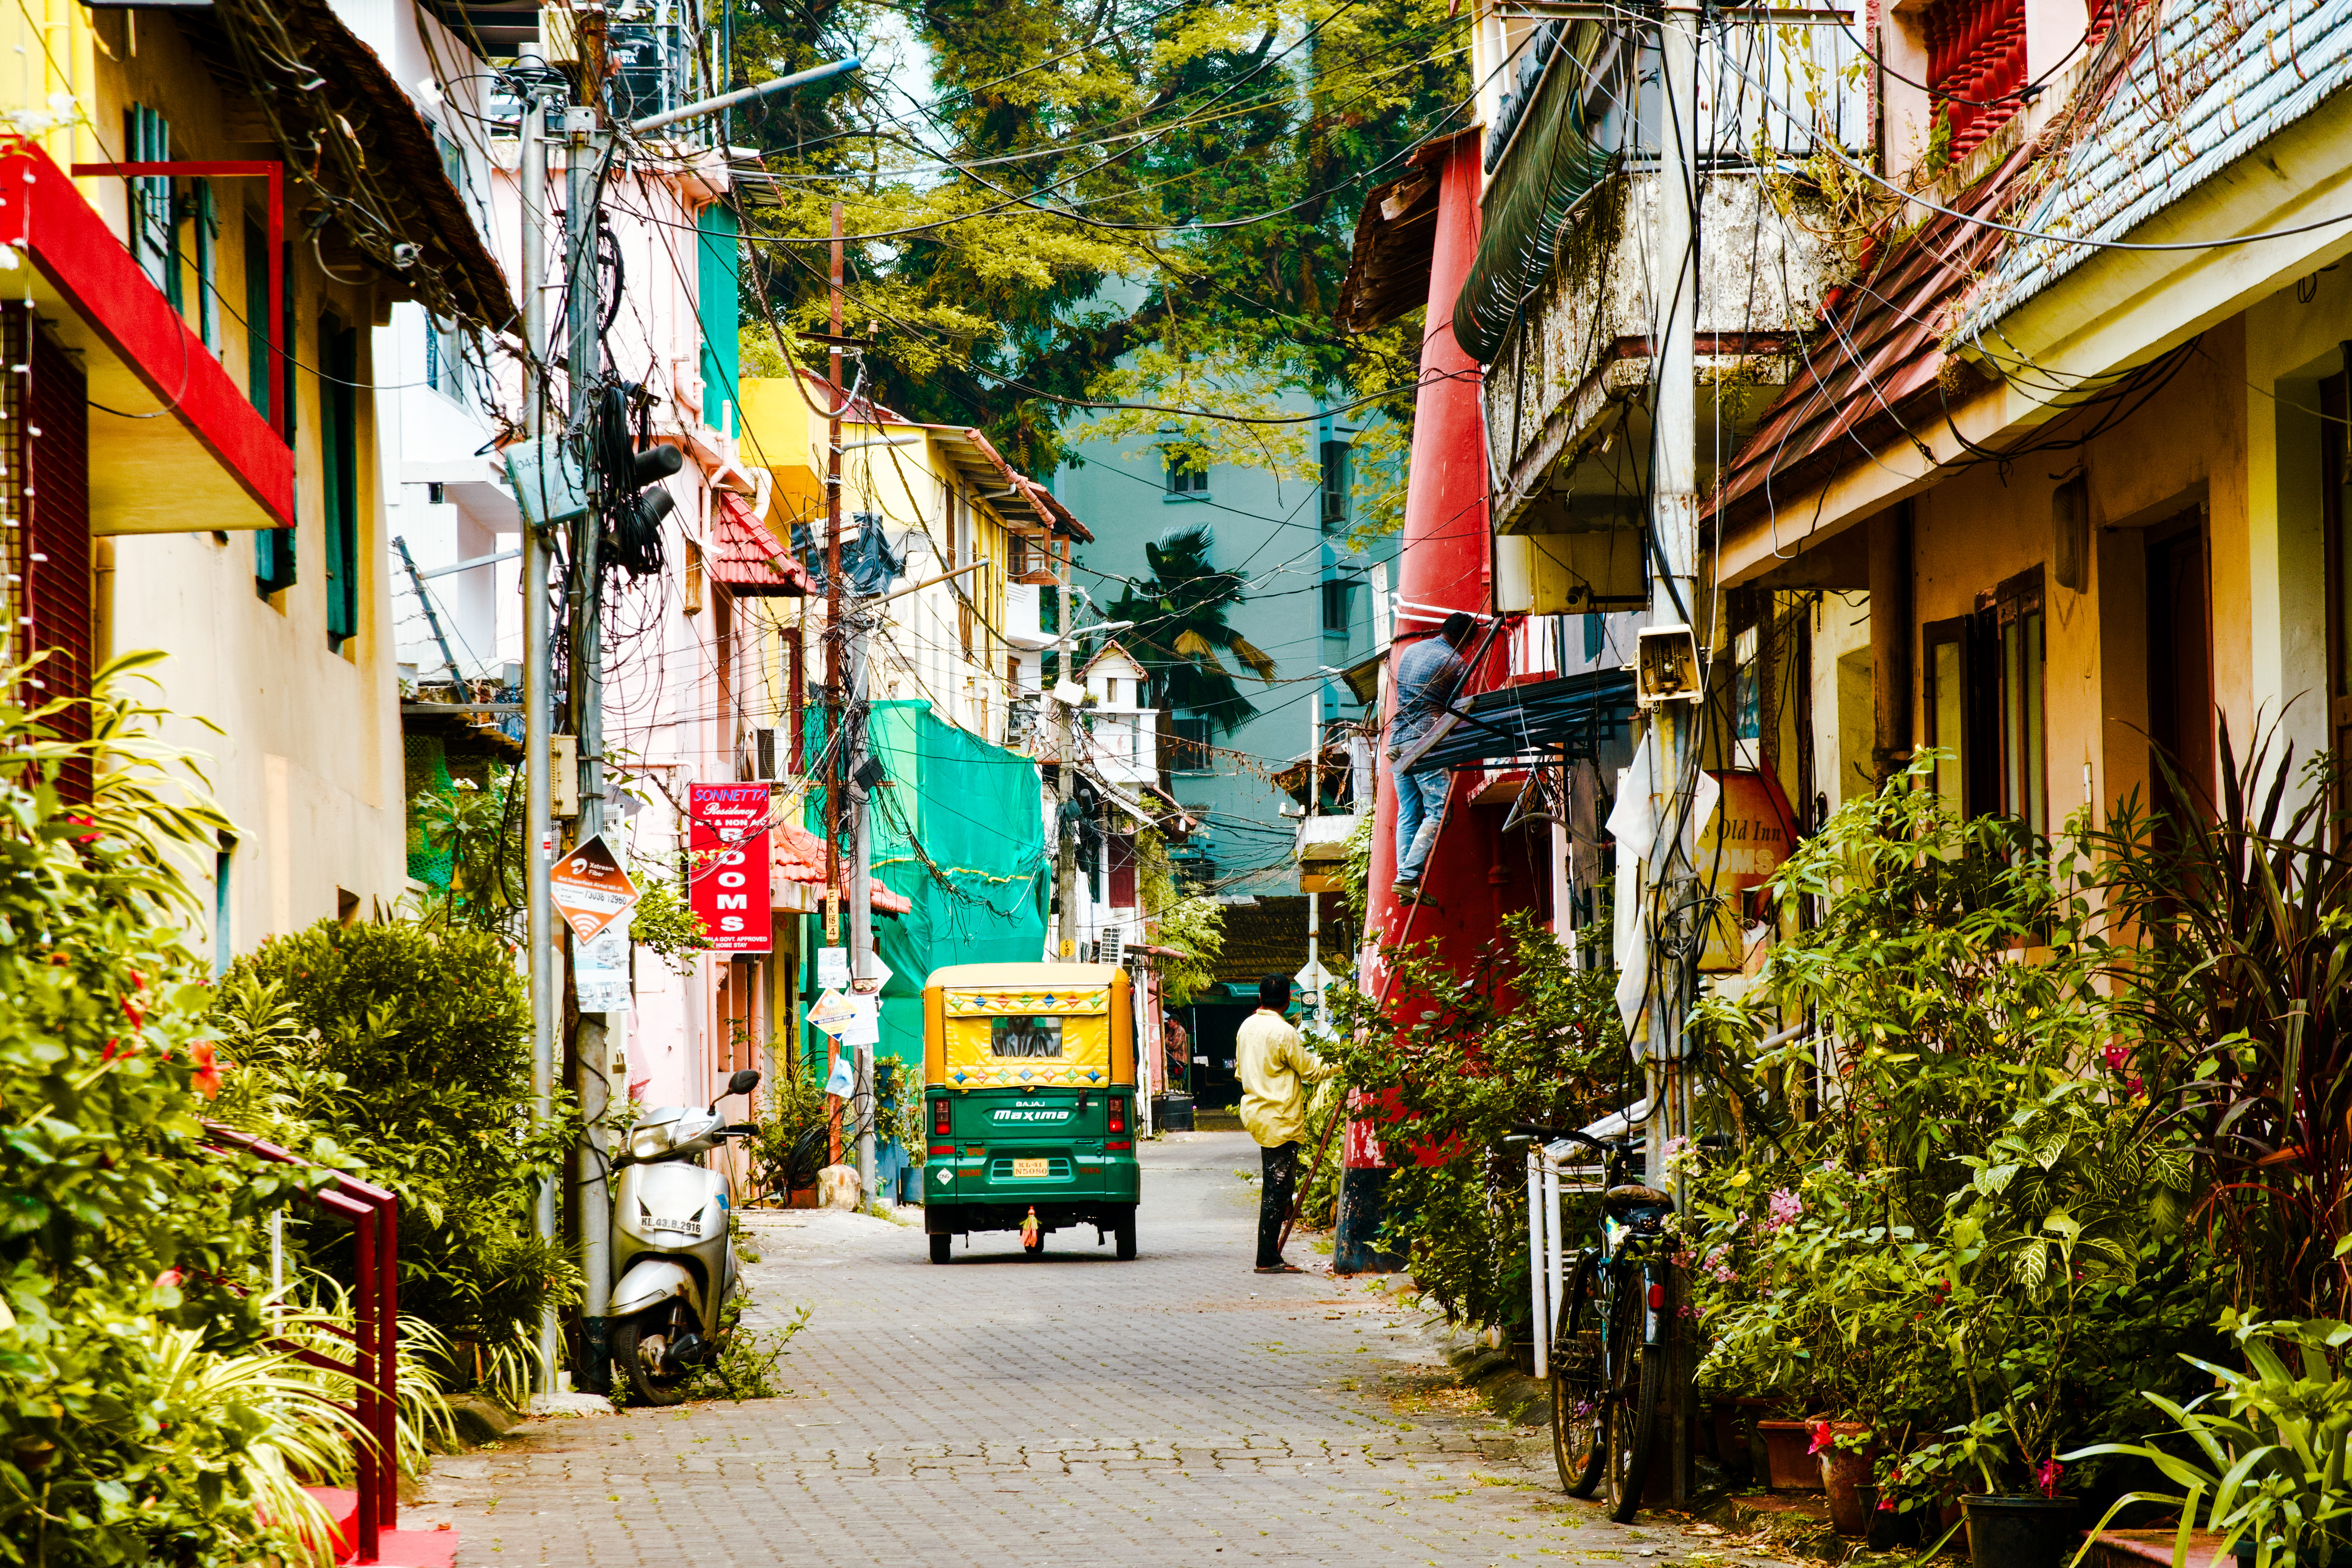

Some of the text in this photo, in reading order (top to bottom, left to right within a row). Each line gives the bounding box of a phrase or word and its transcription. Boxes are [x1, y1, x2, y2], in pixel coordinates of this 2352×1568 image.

[694, 789, 767, 802] SONNETTA
[702, 802, 757, 819] Residency
[1717, 819, 1748, 840] Old
[1753, 821, 1781, 842] Inn
[589, 862, 614, 872] Xstream
[568, 877, 593, 887] Superfast
[717, 828, 747, 931] ROOMS
[829, 892, 834, 901] F
[829, 905, 834, 914] K
[829, 928, 836, 936] 4
[829, 1010, 852, 1018] DARSHAN
[993, 1110, 1069, 1121] Maxima
[967, 1148, 986, 1156] STOP
